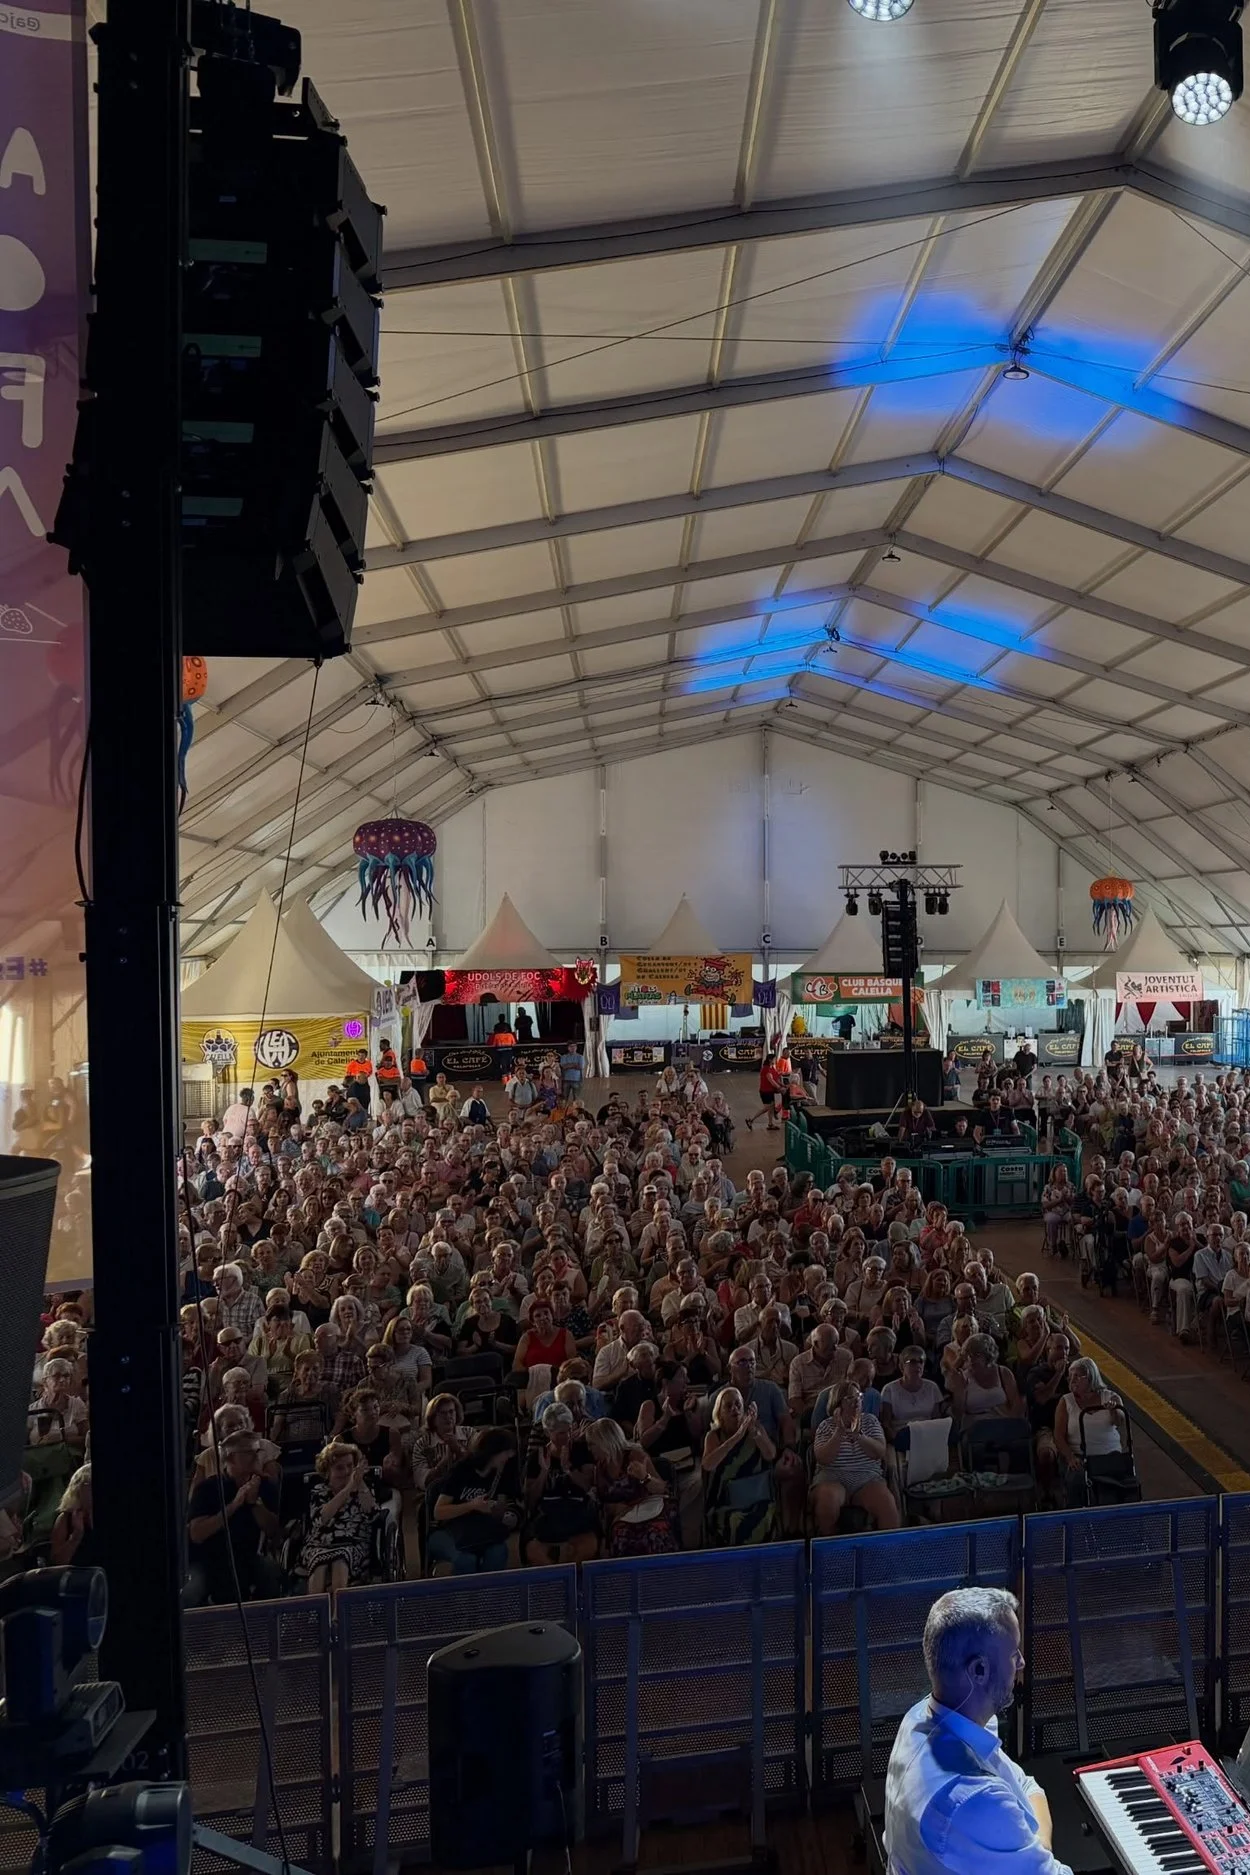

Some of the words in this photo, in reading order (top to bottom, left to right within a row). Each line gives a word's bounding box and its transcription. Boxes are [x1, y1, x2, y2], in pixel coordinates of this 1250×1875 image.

[426, 938, 435, 947] A
[600, 936, 608, 946] B
[763, 934, 771, 944] C
[1059, 937, 1065, 947] E
[467, 972, 501, 981] UDOLS
[504, 972, 518, 981] DE
[521, 971, 541, 981] FOC
[1144, 975, 1195, 985] JOVENTUT
[841, 978, 865, 987] CLUB
[867, 977, 904, 987] BÀSQUE
[852, 988, 893, 996] CALELLA
[1146, 984, 1198, 993] ARTÍSTICA
